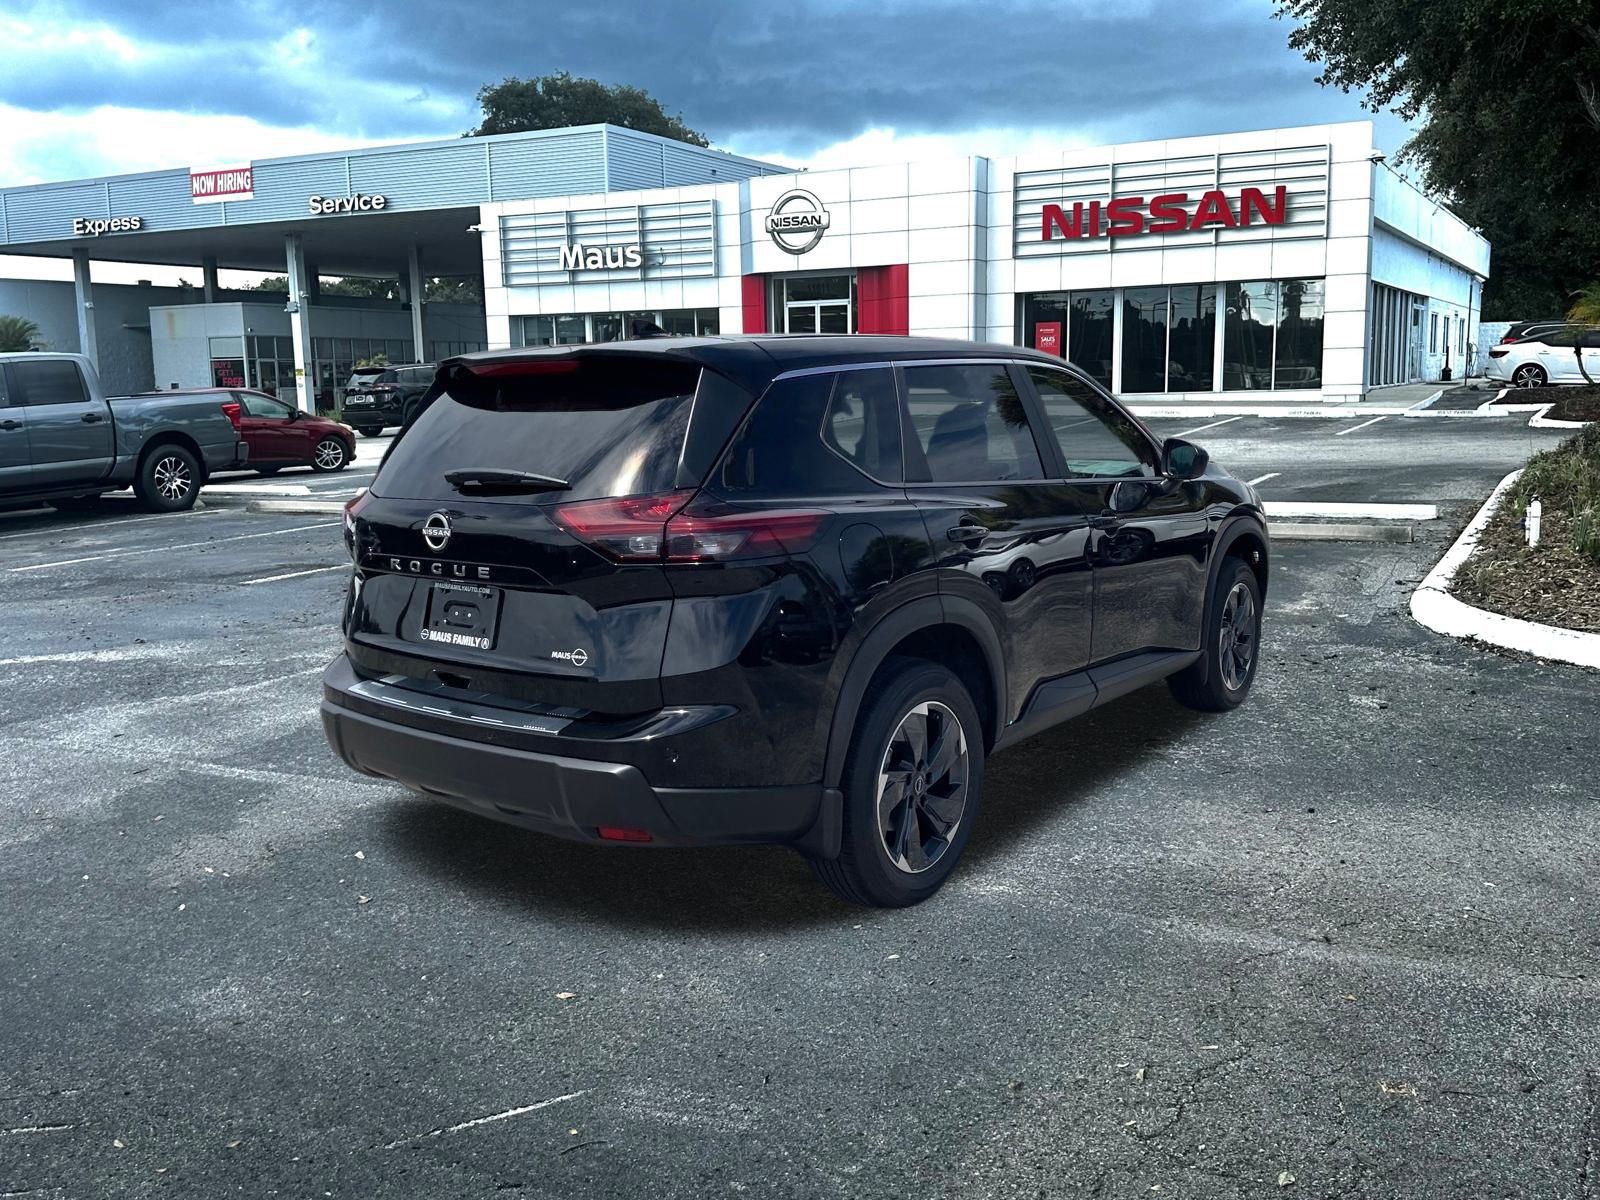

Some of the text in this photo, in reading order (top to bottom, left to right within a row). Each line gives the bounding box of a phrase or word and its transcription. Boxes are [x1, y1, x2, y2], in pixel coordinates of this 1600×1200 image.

[192, 171, 251, 195] NOW HIRING
[309, 193, 386, 215] Service
[1042, 185, 1287, 241] NISSAN
[73, 216, 141, 237] Express
[771, 215, 822, 229] NISSAN
[559, 243, 642, 271] Maus
[222, 377, 244, 386] FREE
[422, 528, 451, 537] NISSAN
[390, 558, 490, 579] ROGUE
[429, 630, 481, 648] MAUS FAMILY
[551, 651, 571, 660] MAUS
